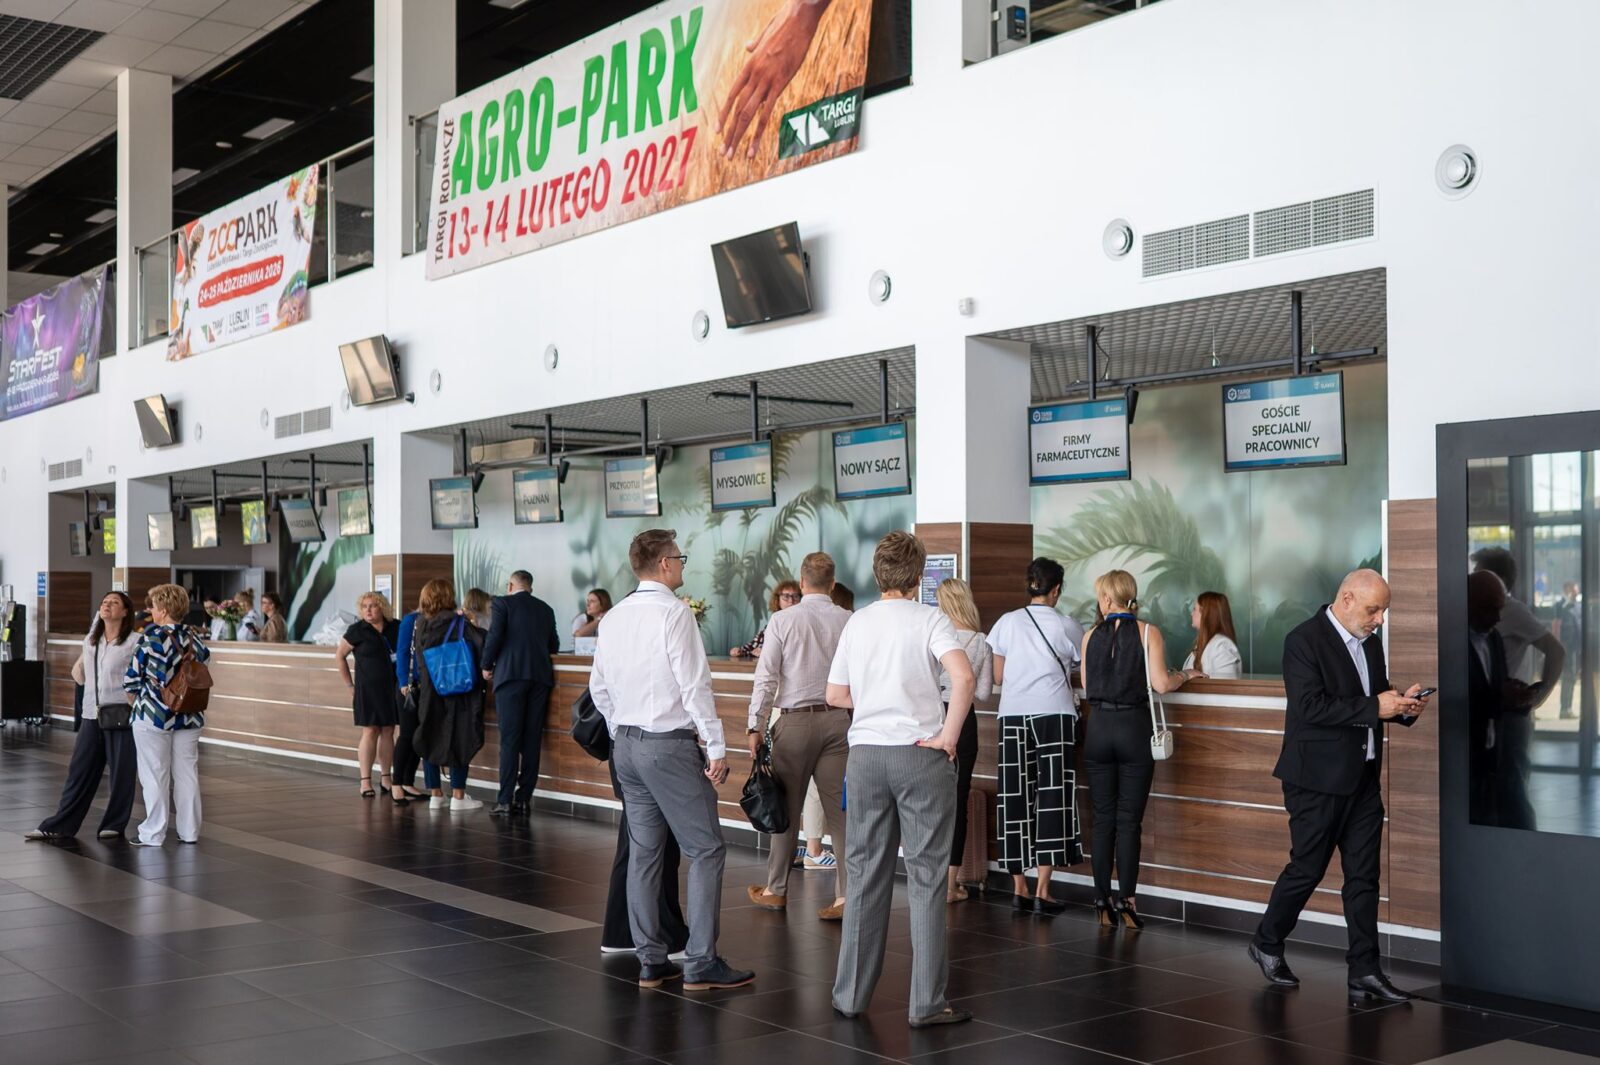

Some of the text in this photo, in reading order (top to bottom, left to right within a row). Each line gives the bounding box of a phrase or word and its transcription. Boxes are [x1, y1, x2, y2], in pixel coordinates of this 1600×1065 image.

[451, 6, 704, 200] AGRO-PARK
[821, 94, 857, 122] TARGI
[834, 113, 856, 128] LUBLIN
[434, 117, 455, 264] TARGI ROLNICZE
[516, 158, 612, 238] LUTEGO
[621, 126, 698, 205] 2027
[207, 200, 278, 262] ZOOPARK
[217, 268, 264, 295] PAŹDZIERNIKA
[265, 260, 282, 280] 2026
[1261, 404, 1301, 419] GOŚCIE
[1252, 421, 1312, 436] SPECJALNI/
[1063, 434, 1092, 446] FIRMY
[1245, 437, 1320, 453] PRACOWNICY
[1036, 446, 1120, 463] FARMACEUTYCZNE
[840, 457, 901, 477] NOWY SĄCZ
[716, 473, 766, 489] MYSŁOWICE
[523, 491, 550, 505] POZNAŃ
